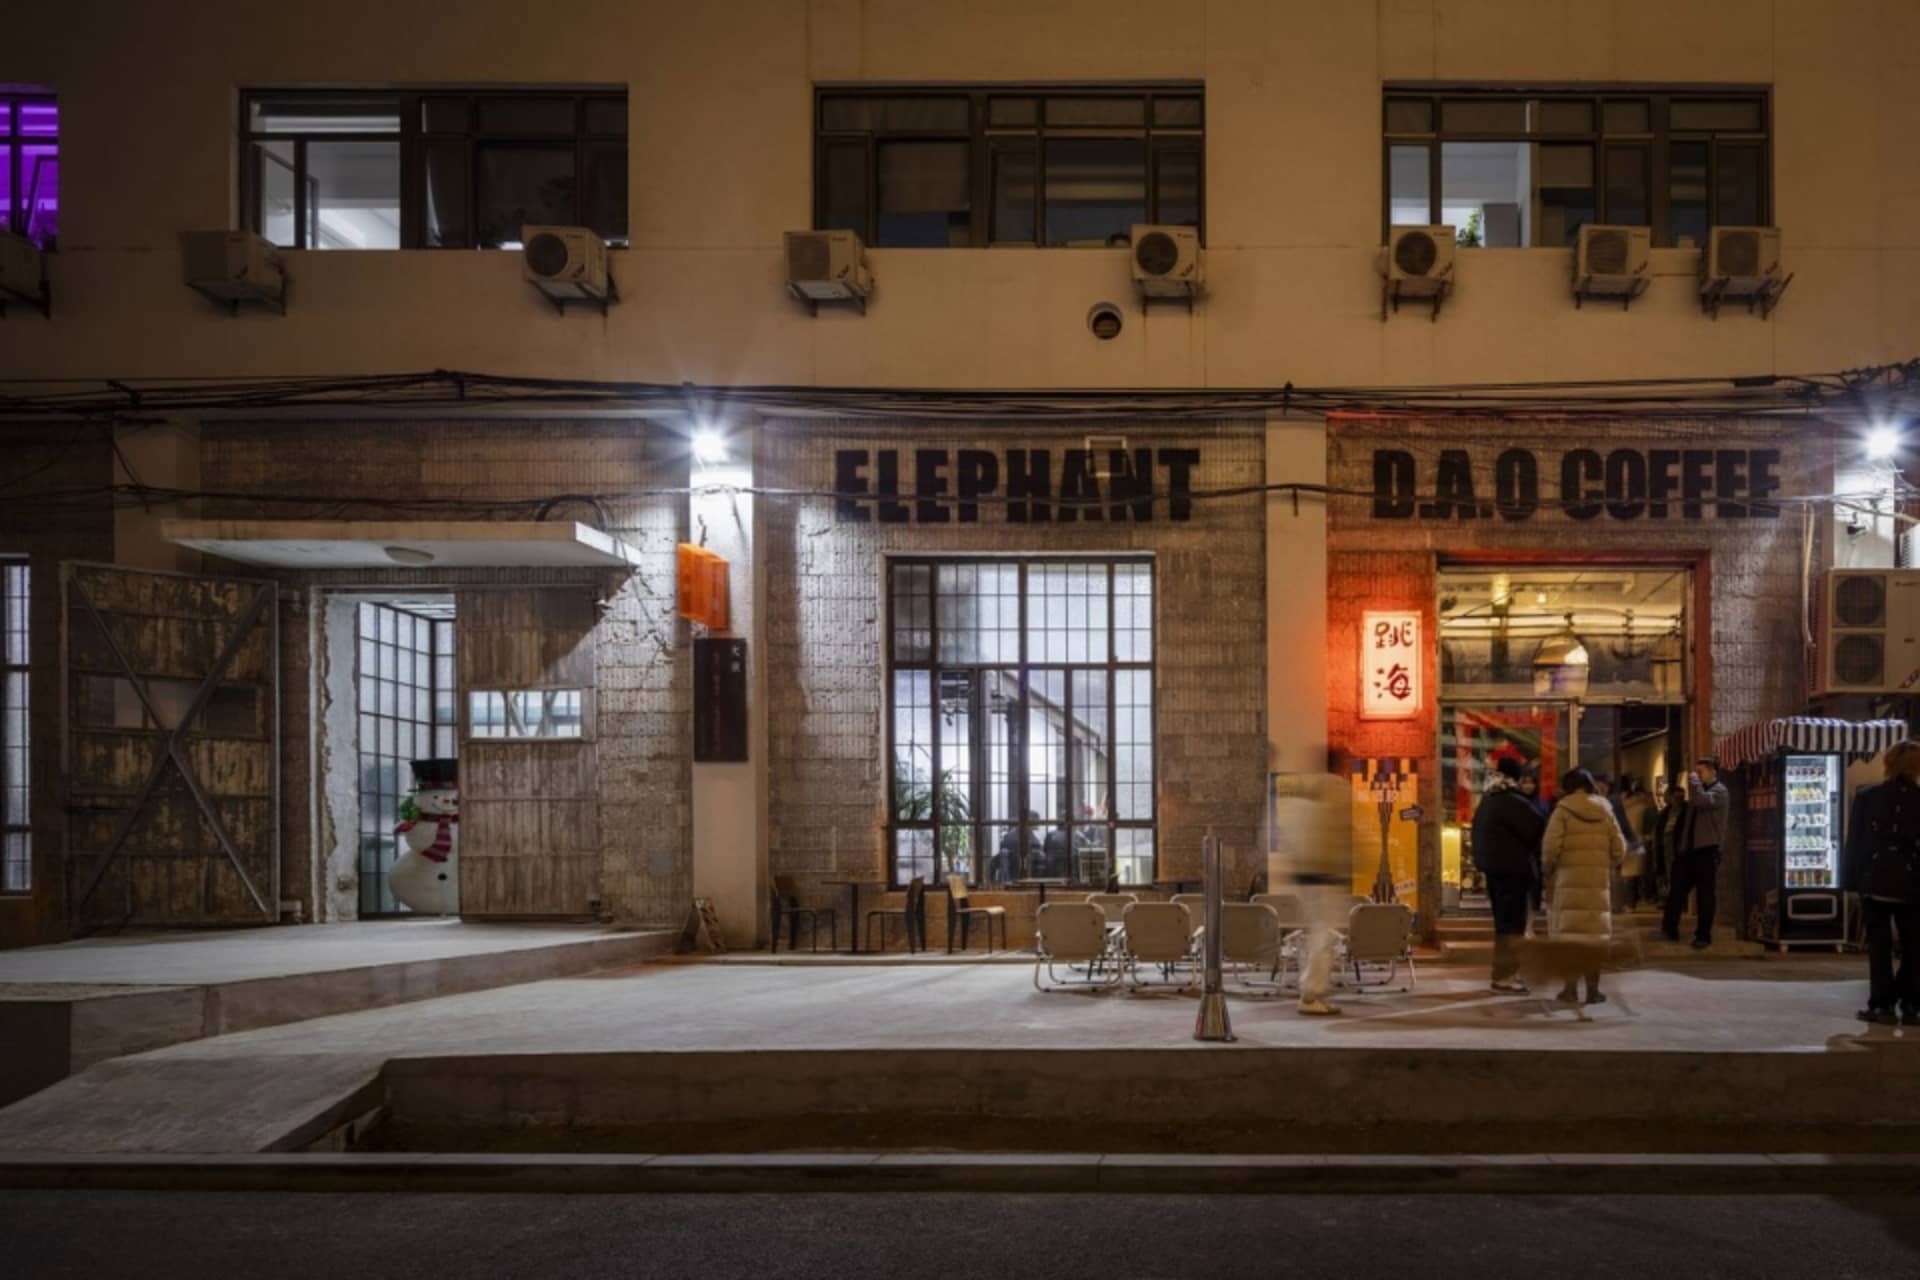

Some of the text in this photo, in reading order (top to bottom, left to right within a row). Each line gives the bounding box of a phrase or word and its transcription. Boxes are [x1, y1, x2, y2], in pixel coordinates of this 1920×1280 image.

[835, 448, 1200, 522] ELEPHANT
[1373, 447, 1781, 520] D.A.O COFFEE
[1373, 620, 1414, 701] 跳海
